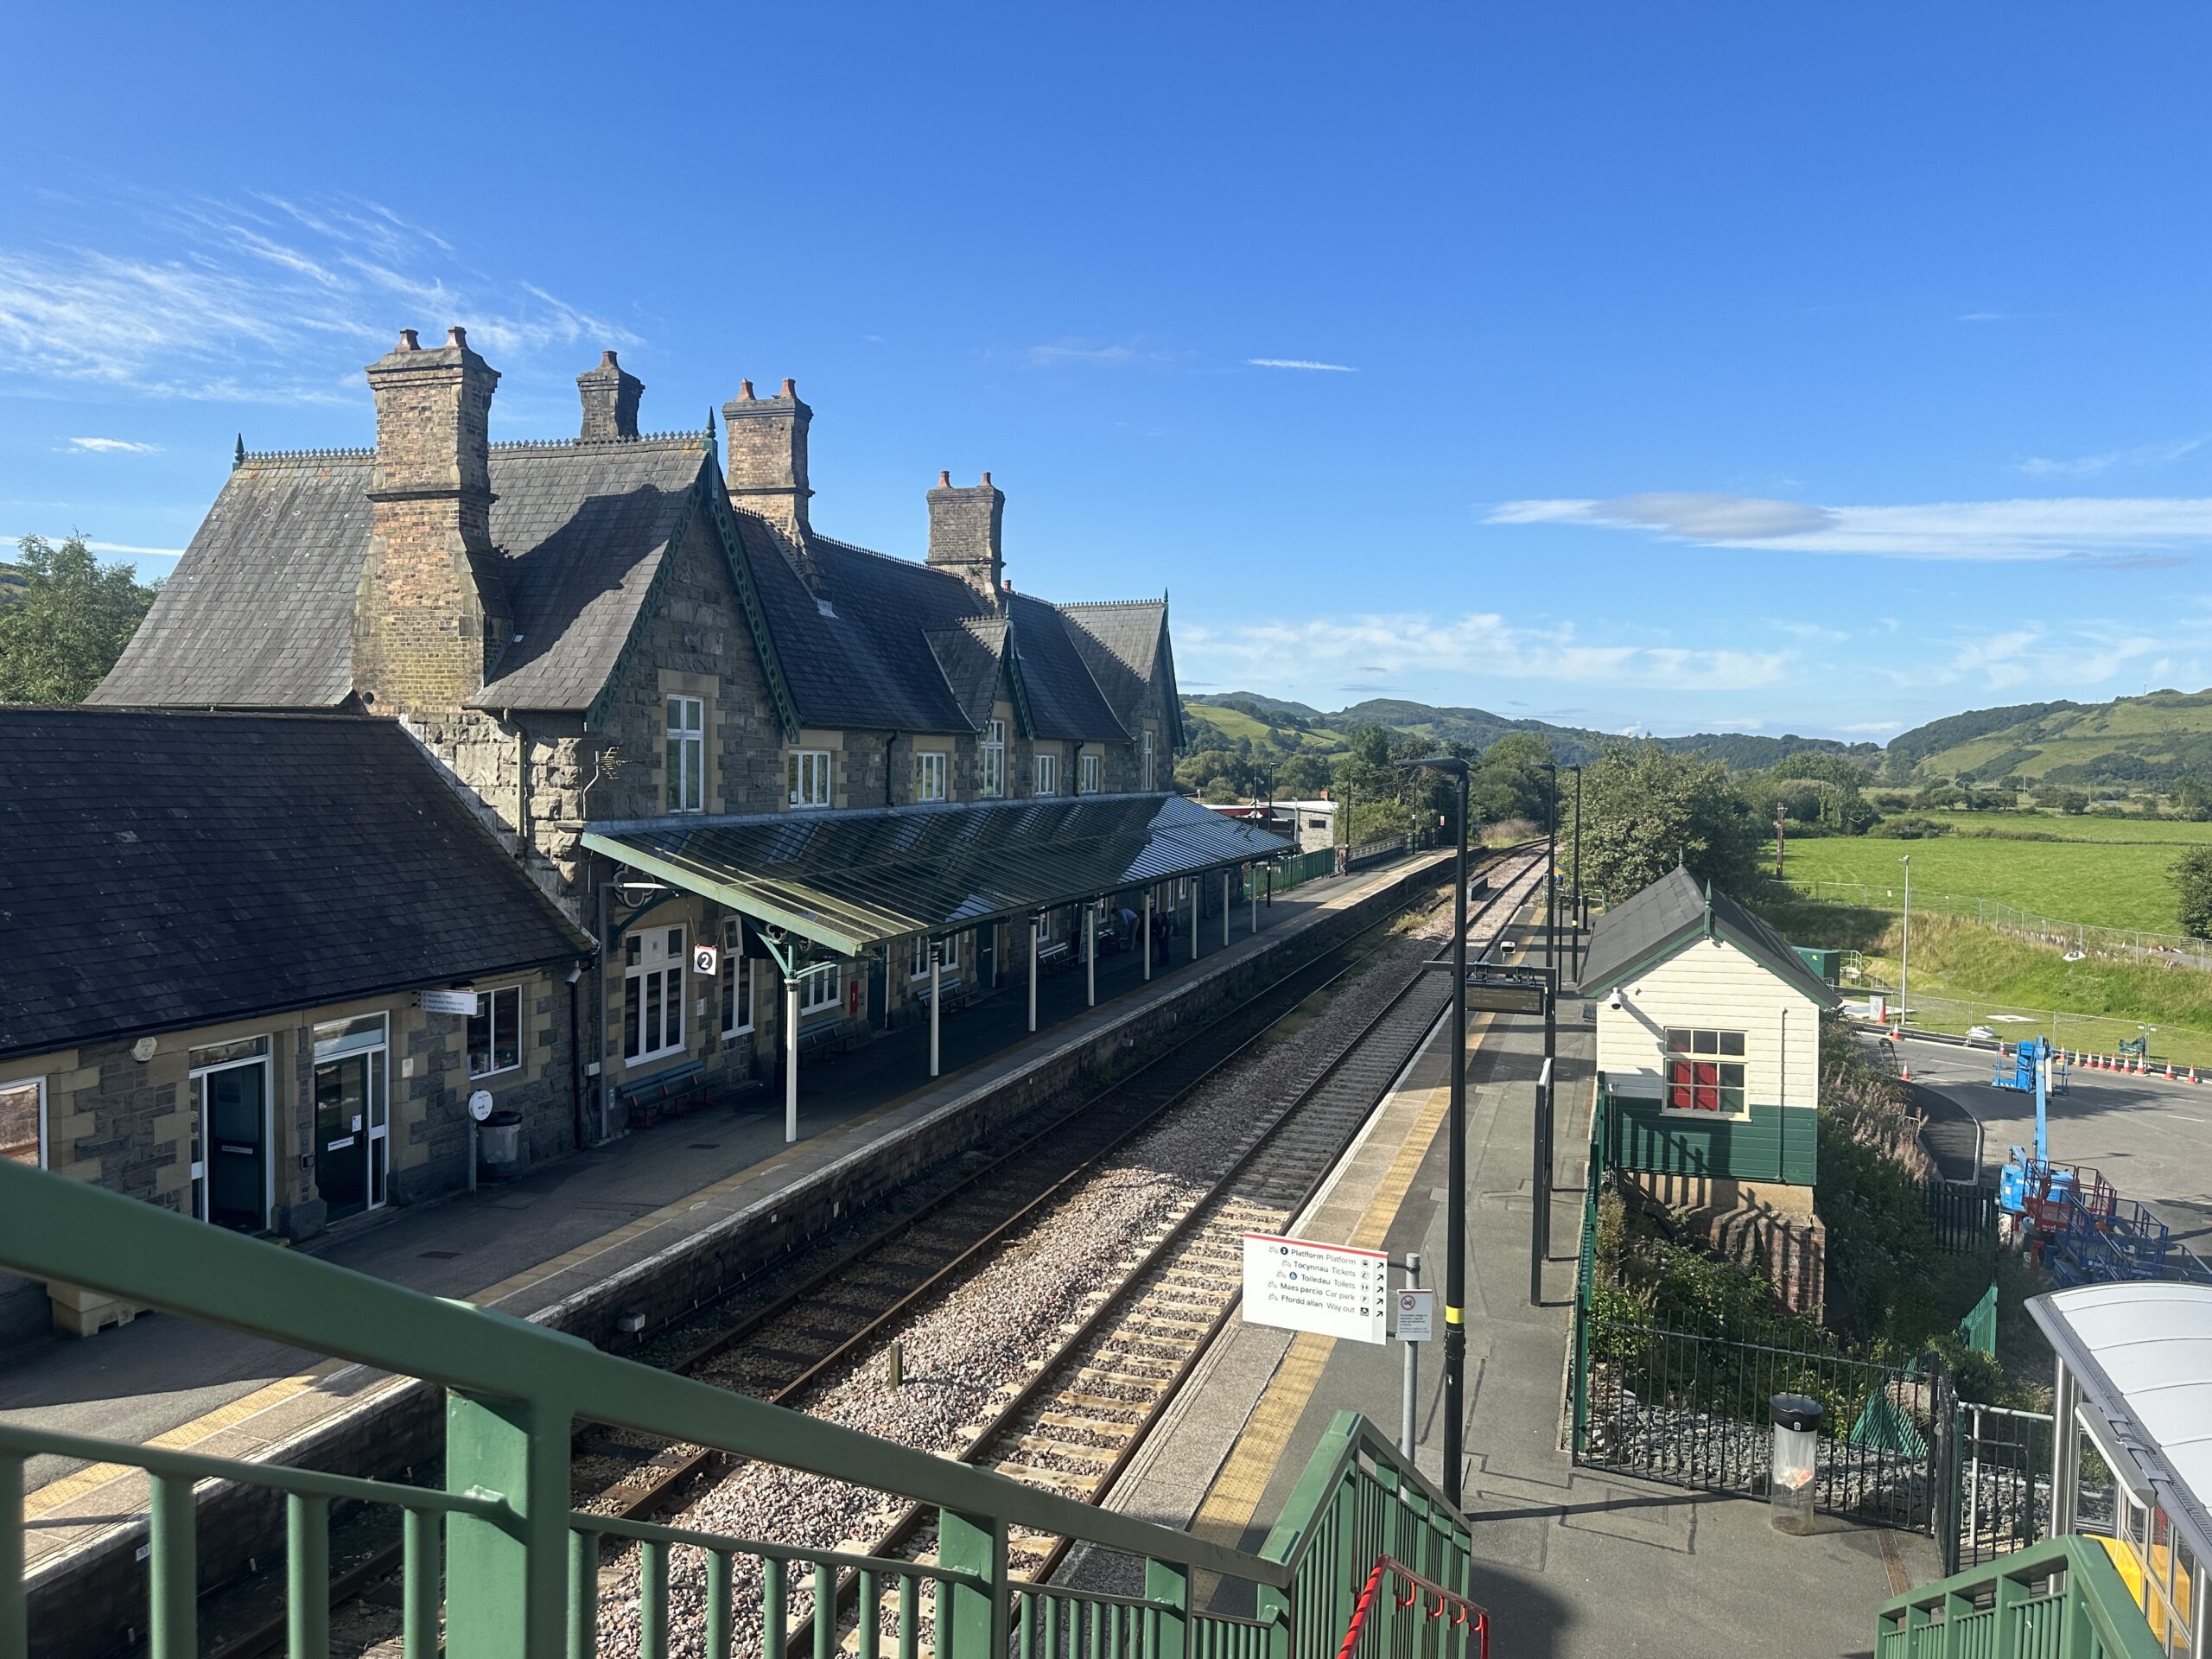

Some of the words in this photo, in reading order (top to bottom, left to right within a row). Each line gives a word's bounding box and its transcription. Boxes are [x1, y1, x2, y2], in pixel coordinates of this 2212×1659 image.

[701, 954, 709, 969] 2
[1291, 1249, 1324, 1260] Platfform
[1325, 1254, 1357, 1265] Platform
[1294, 1261, 1329, 1273] Tocynnau
[1332, 1266, 1356, 1277] Tickets
[1301, 1274, 1331, 1285] Toiledau
[1334, 1279, 1356, 1289] Toilets
[1280, 1282, 1299, 1292] Maes
[1300, 1287, 1323, 1295] parcio
[1325, 1289, 1338, 1298] Car
[1338, 1293, 1356, 1301] park
[1281, 1294, 1305, 1306] Ffordd
[1306, 1299, 1324, 1308] allan
[1326, 1302, 1342, 1313] Way
